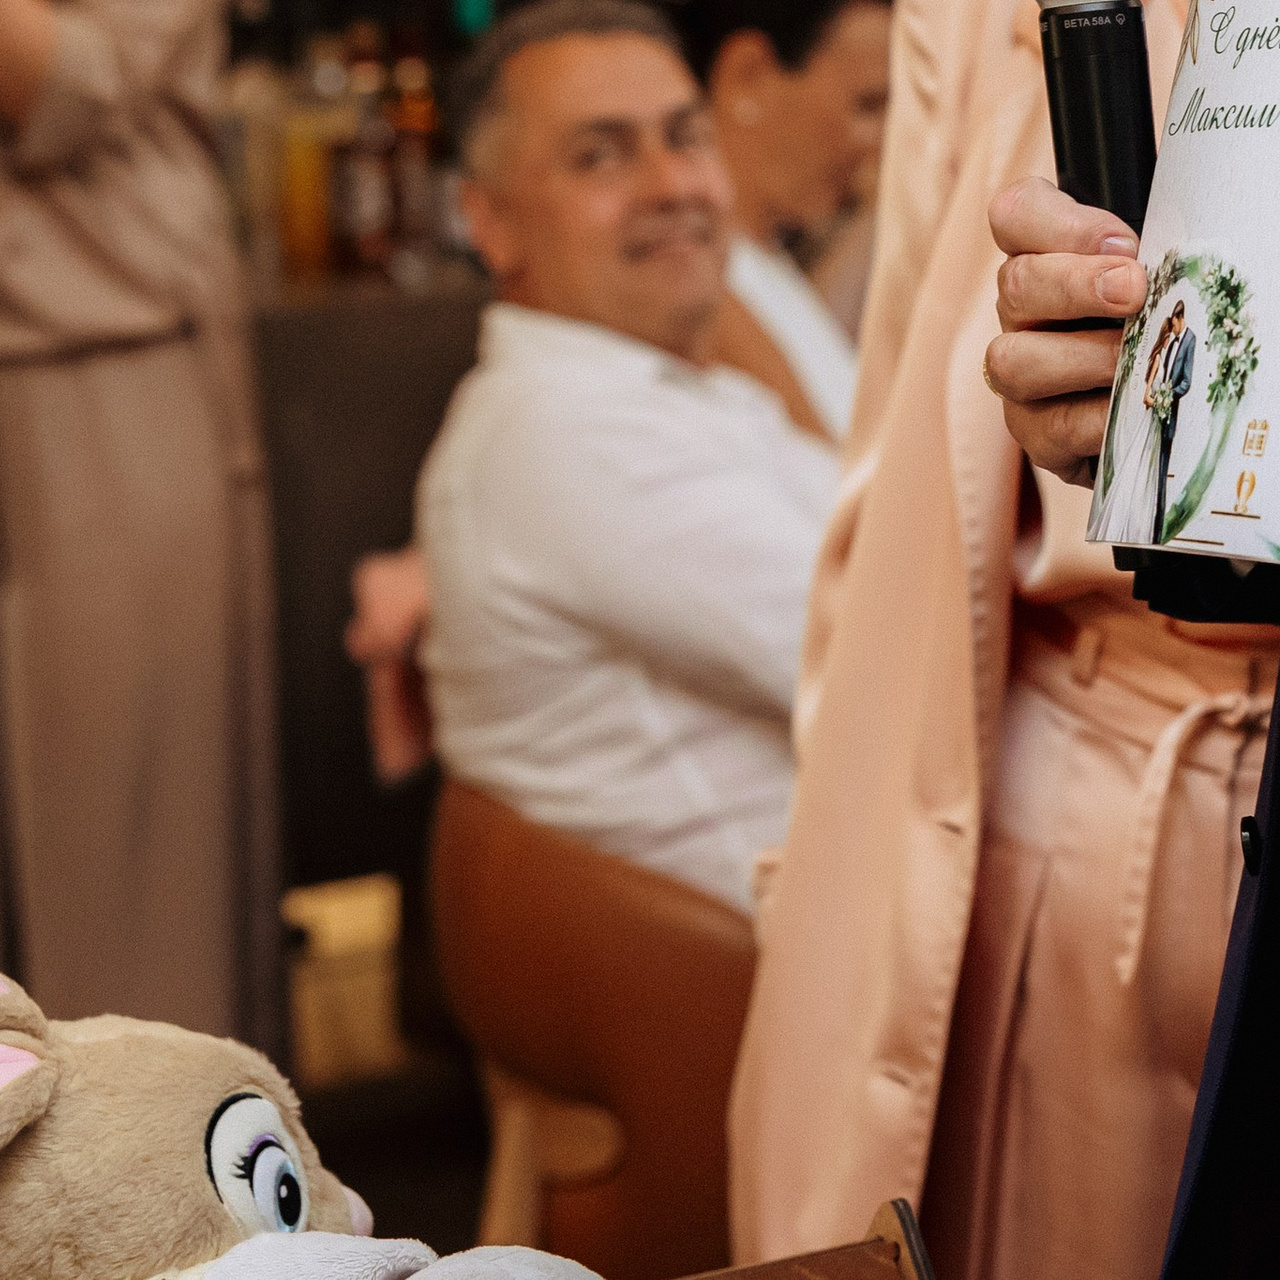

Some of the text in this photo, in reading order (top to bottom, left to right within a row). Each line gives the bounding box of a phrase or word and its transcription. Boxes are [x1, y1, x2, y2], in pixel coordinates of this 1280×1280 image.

[1064, 16, 1111, 29] BETA 58A
[1210, 6, 1236, 54] С
